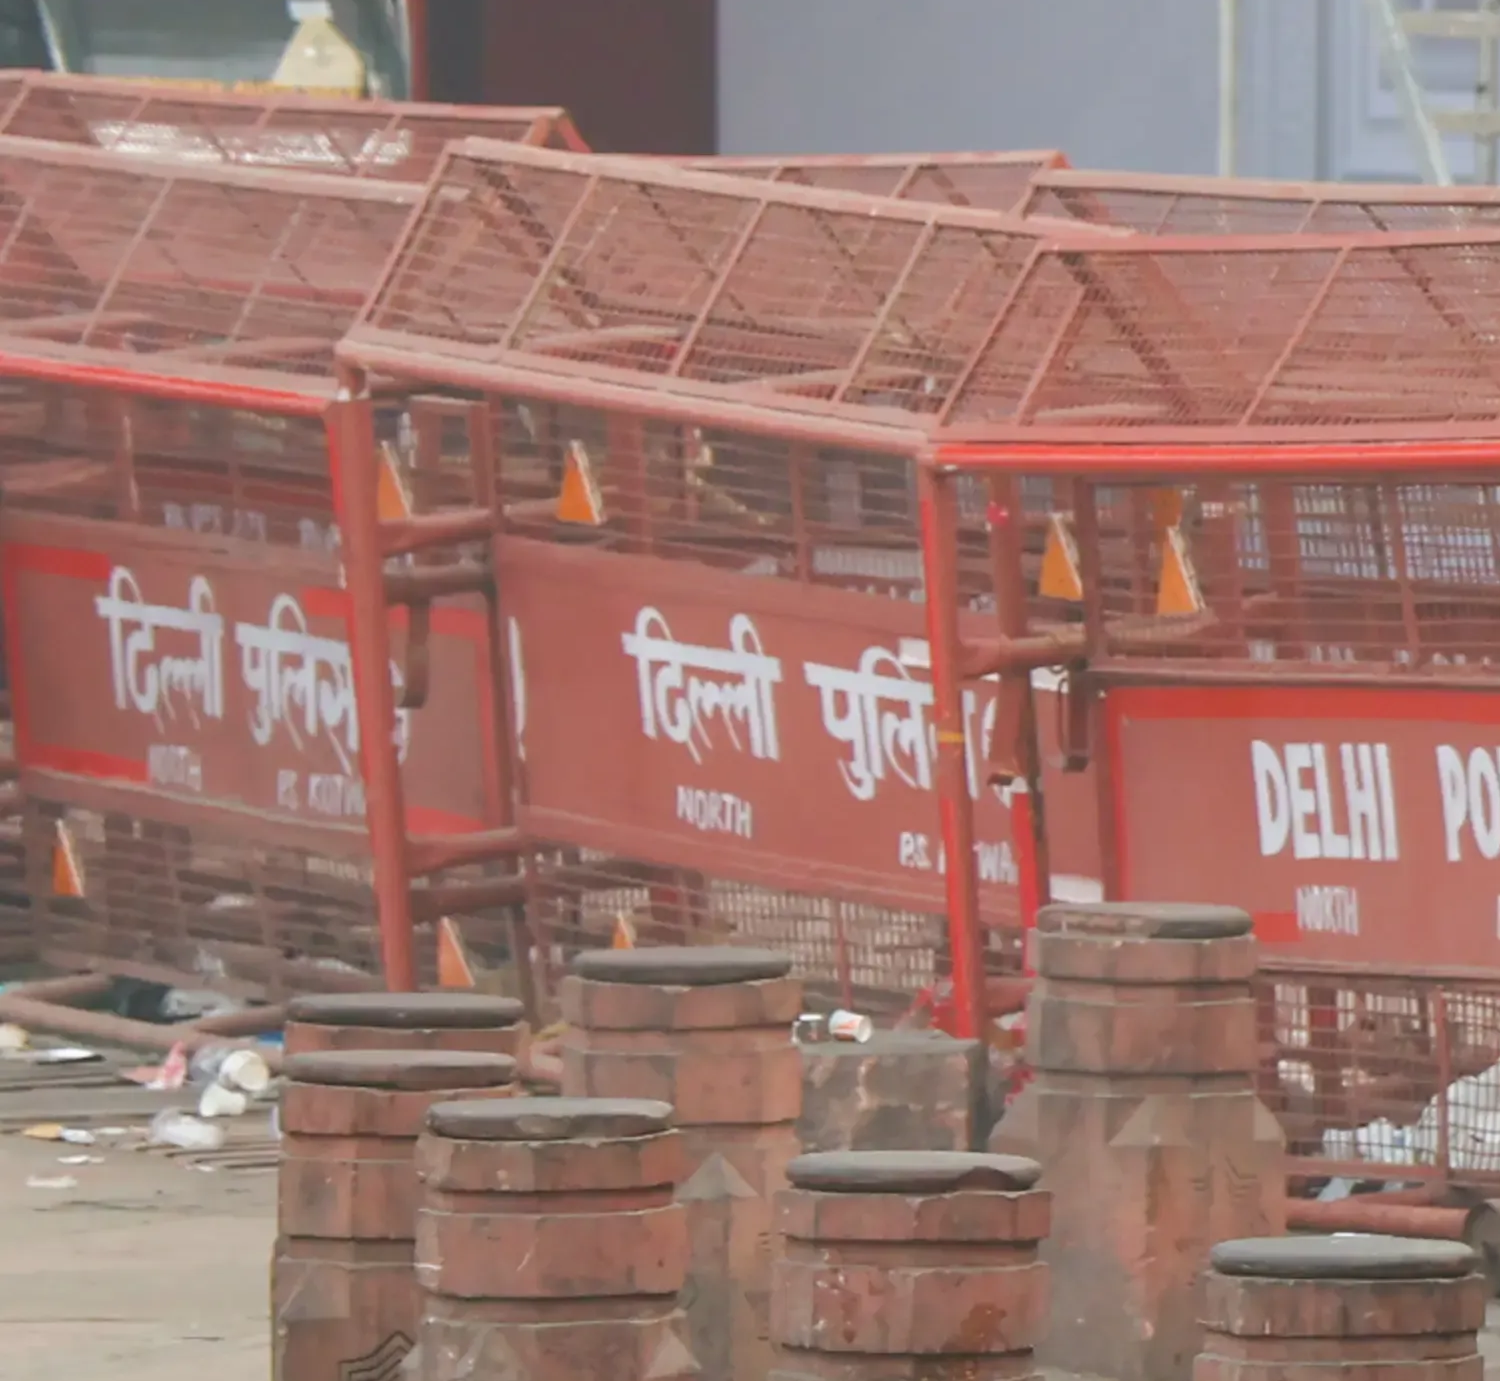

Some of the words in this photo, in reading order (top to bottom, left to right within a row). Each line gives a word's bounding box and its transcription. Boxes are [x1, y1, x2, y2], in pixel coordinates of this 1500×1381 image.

[94, 565, 224, 735] दिल्ली
[621, 606, 783, 765] दिल्ली
[804, 646, 979, 801] पुलि
[675, 785, 753, 840] NORTH
[1251, 739, 1399, 861] DELHI
